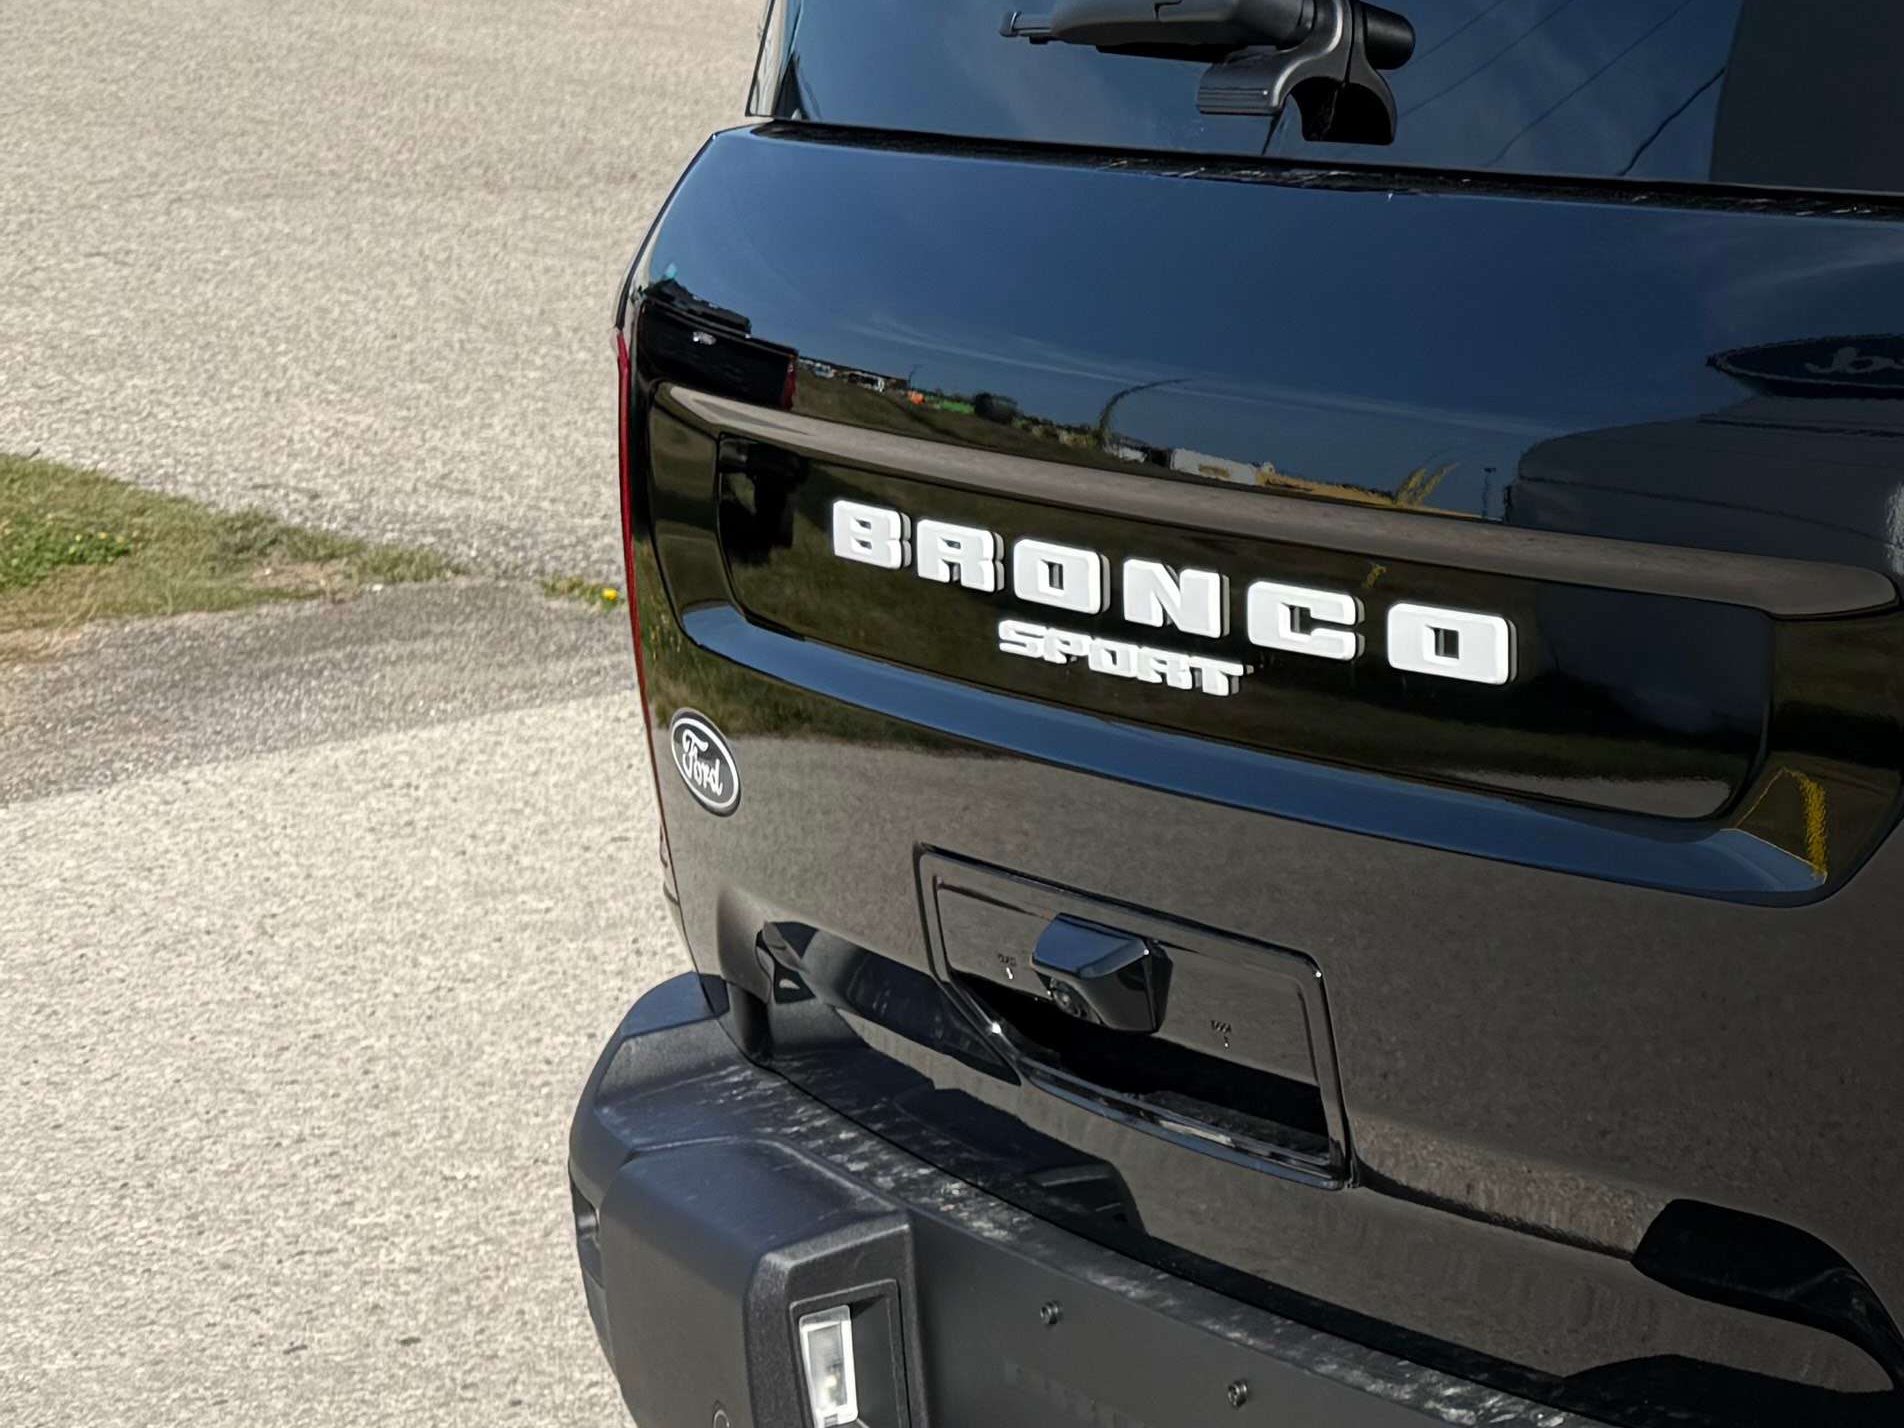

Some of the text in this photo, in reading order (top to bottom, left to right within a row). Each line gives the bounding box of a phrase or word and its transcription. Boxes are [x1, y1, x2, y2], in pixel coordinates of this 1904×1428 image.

[832, 499, 1518, 687] BRONCO
[998, 618, 1255, 697] SPORT
[682, 728, 724, 797] Ford
